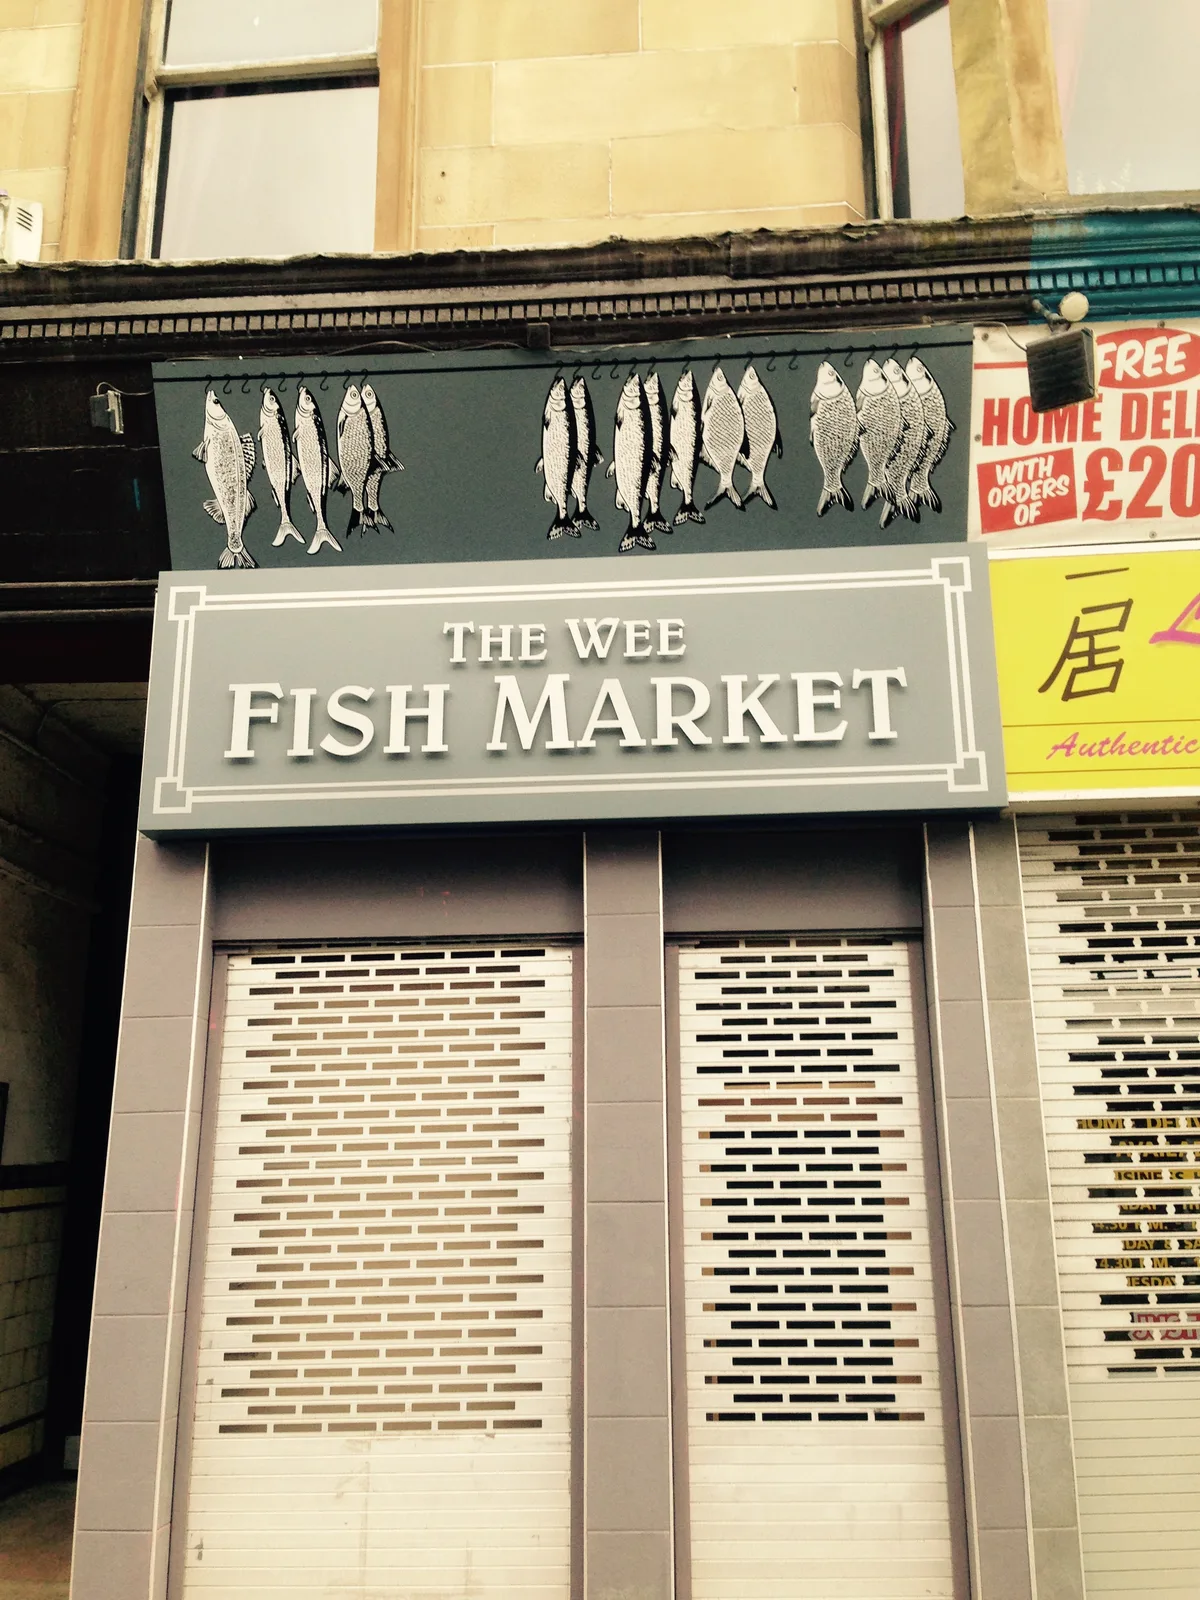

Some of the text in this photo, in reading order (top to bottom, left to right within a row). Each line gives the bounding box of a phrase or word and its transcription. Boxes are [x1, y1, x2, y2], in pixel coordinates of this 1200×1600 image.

[1098, 333, 1192, 381] FREE
[982, 393, 1104, 447] HOME
[995, 455, 1055, 486] WITH
[987, 474, 1070, 508] ORDERS
[1013, 501, 1044, 526] OF
[443, 617, 687, 663] THE WEE
[224, 666, 908, 758] FISH MARKET
[1046, 731, 1200, 760] Authentic
